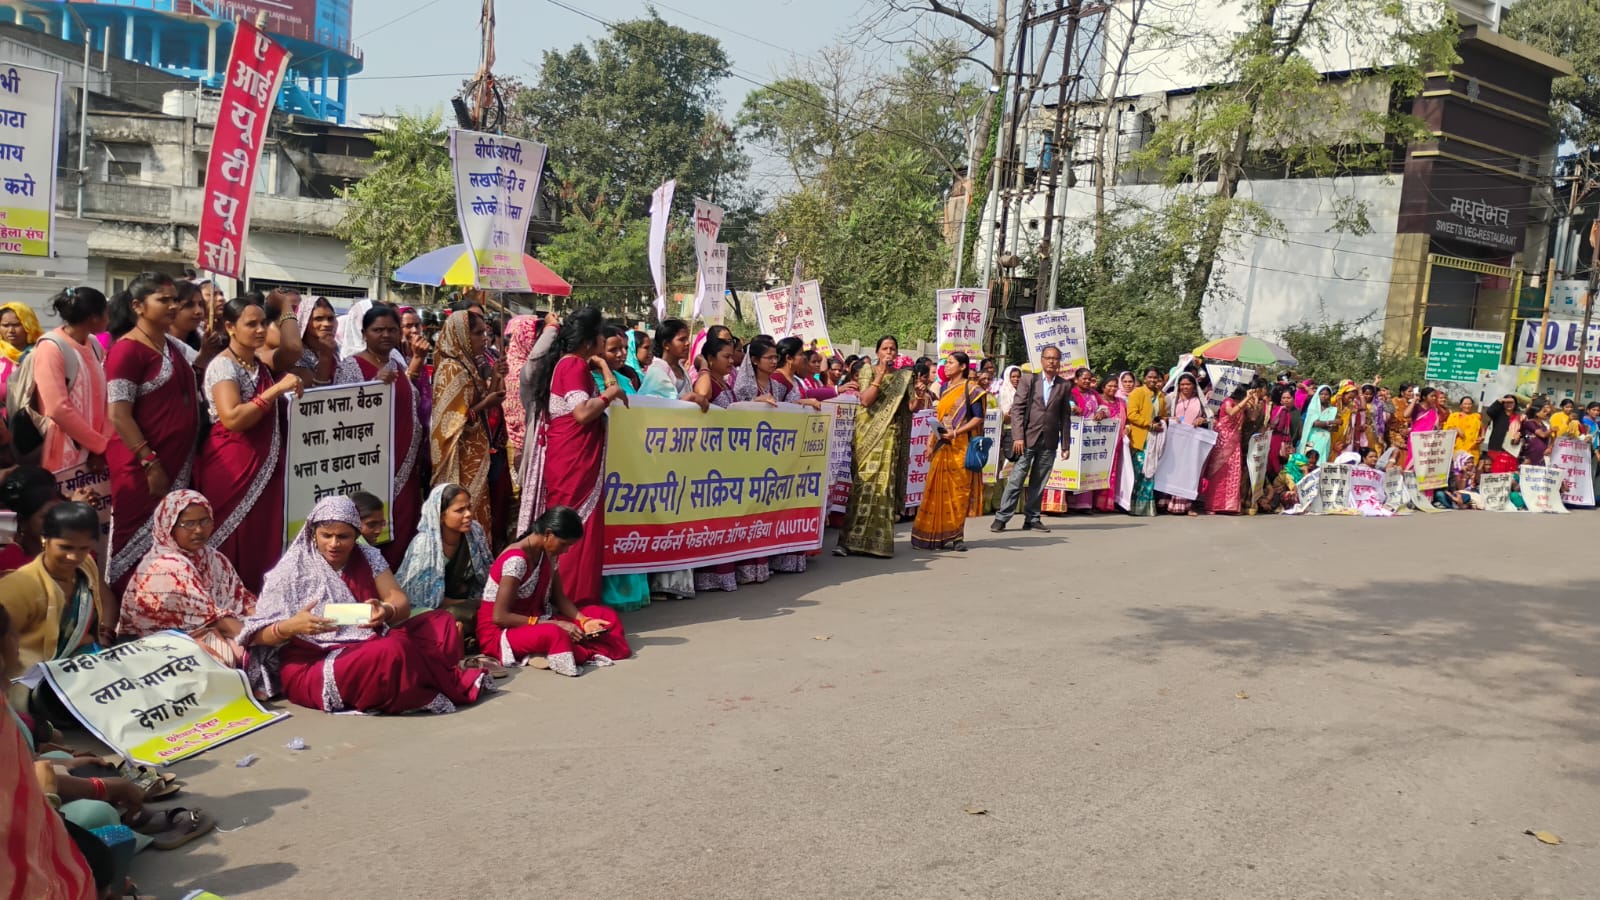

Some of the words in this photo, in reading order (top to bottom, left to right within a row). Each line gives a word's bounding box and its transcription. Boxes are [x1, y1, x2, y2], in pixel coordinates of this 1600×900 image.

[254, 32, 272, 62] ए
[232, 60, 274, 109] आई
[231, 101, 257, 149] यू
[221, 149, 249, 187] टी
[4, 173, 36, 197] करो
[518, 178, 526, 193] व
[213, 191, 240, 235] यू
[1436, 220, 1462, 234] SWEETS
[203, 239, 236, 274] सी
[964, 325, 976, 339] होगा
[967, 308, 982, 324] वृद्धि
[299, 400, 324, 417] यात्रा
[327, 397, 353, 413] भत्ता,
[357, 387, 383, 409] बैठक
[302, 430, 328, 447] भत्ता,
[333, 421, 374, 442] मोबाइल
[645, 427, 668, 453] एन
[669, 427, 697, 453] आर
[700, 427, 723, 453] एल
[728, 427, 752, 452] एम
[756, 421, 798, 455] बिहान
[294, 461, 317, 478] भत्ता
[320, 459, 329, 473] व
[331, 455, 356, 473] डाटा
[358, 444, 381, 466] चार्ज
[691, 469, 744, 509] सक्रिय
[749, 467, 795, 507] महिला
[796, 465, 822, 499] संघ
[613, 530, 649, 554] स्कीम
[651, 527, 685, 551] वर्कर्स
[685, 524, 726, 548] फेडरेशन
[725, 521, 749, 543] ऑफ
[748, 519, 772, 543] इंडिया
[775, 516, 820, 538] (AIUTUC)
[139, 655, 200, 688] मानदेय
[130, 704, 169, 730] देना
